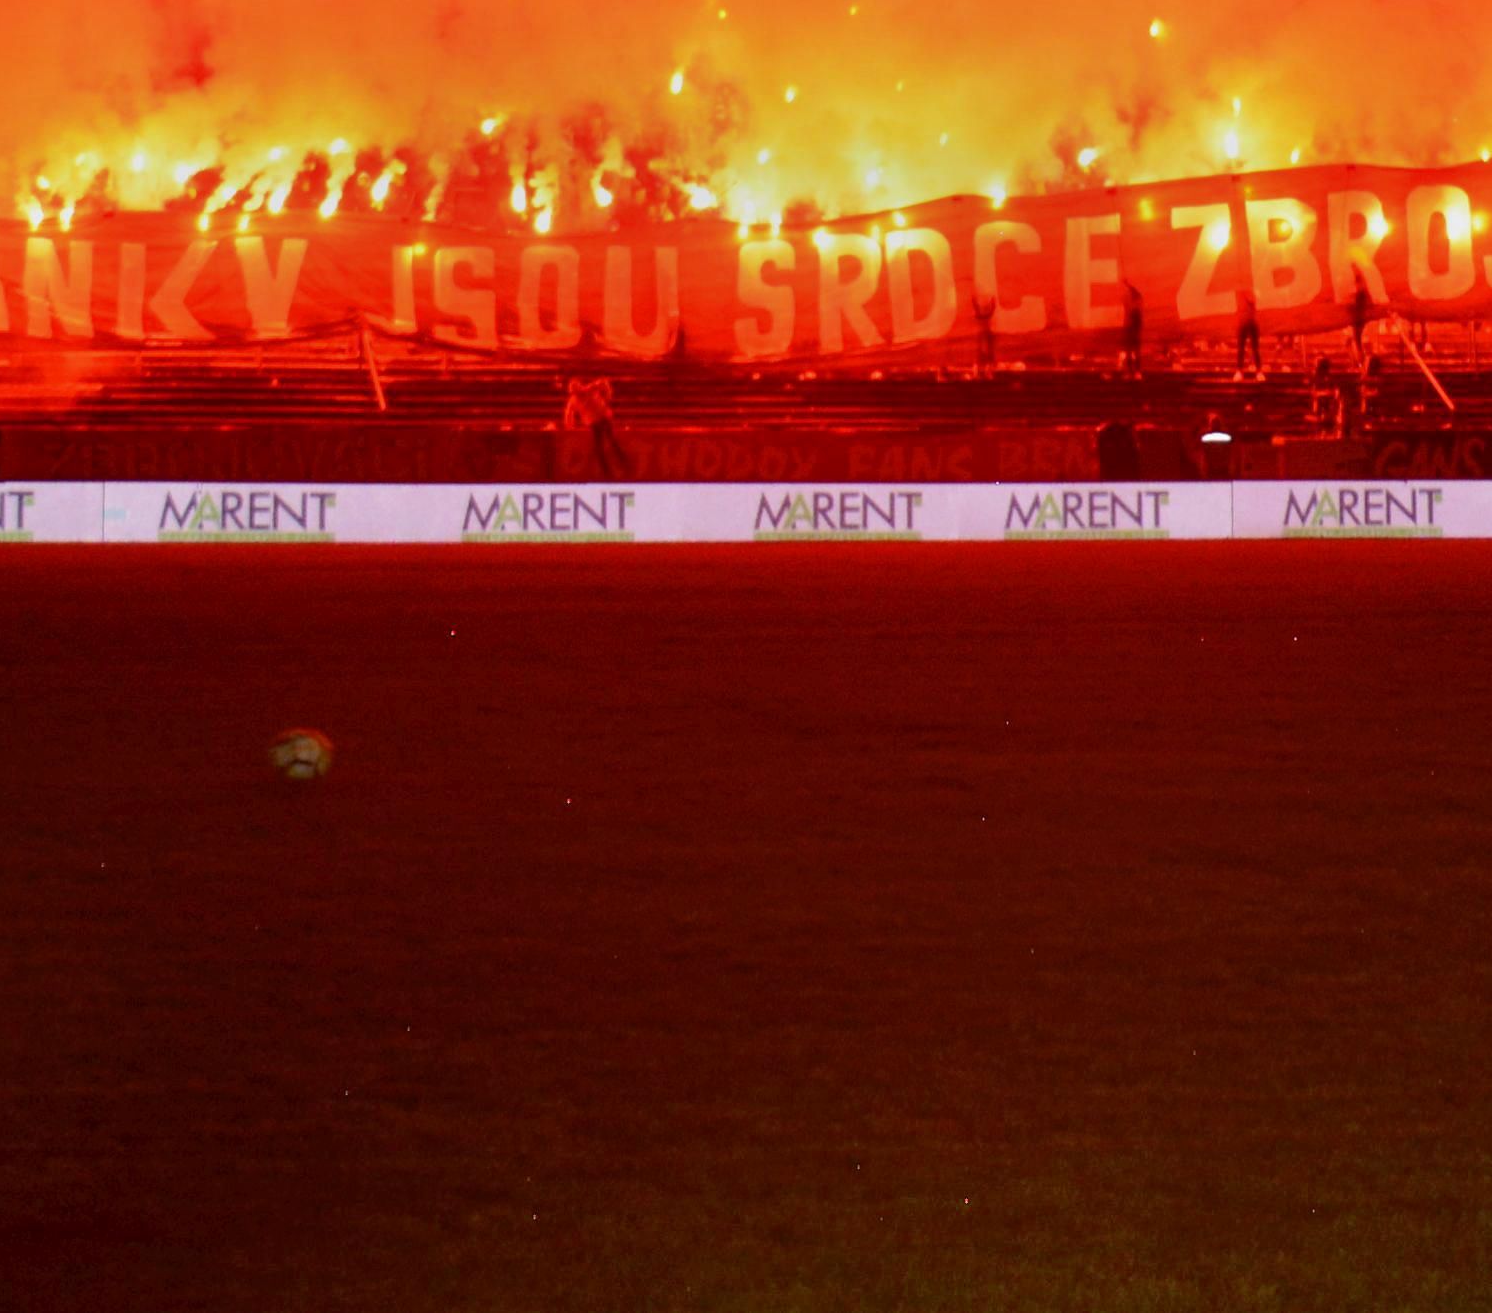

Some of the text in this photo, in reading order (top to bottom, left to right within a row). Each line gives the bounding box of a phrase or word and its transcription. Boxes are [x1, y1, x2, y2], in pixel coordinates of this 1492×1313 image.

[733, 213, 1125, 358] SRDCE
[160, 492, 336, 531] MARENT
[463, 492, 636, 531] MARENT
[755, 492, 923, 531] MARENT
[1006, 491, 1170, 530] MARENT
[1284, 489, 1443, 527] MARENT
